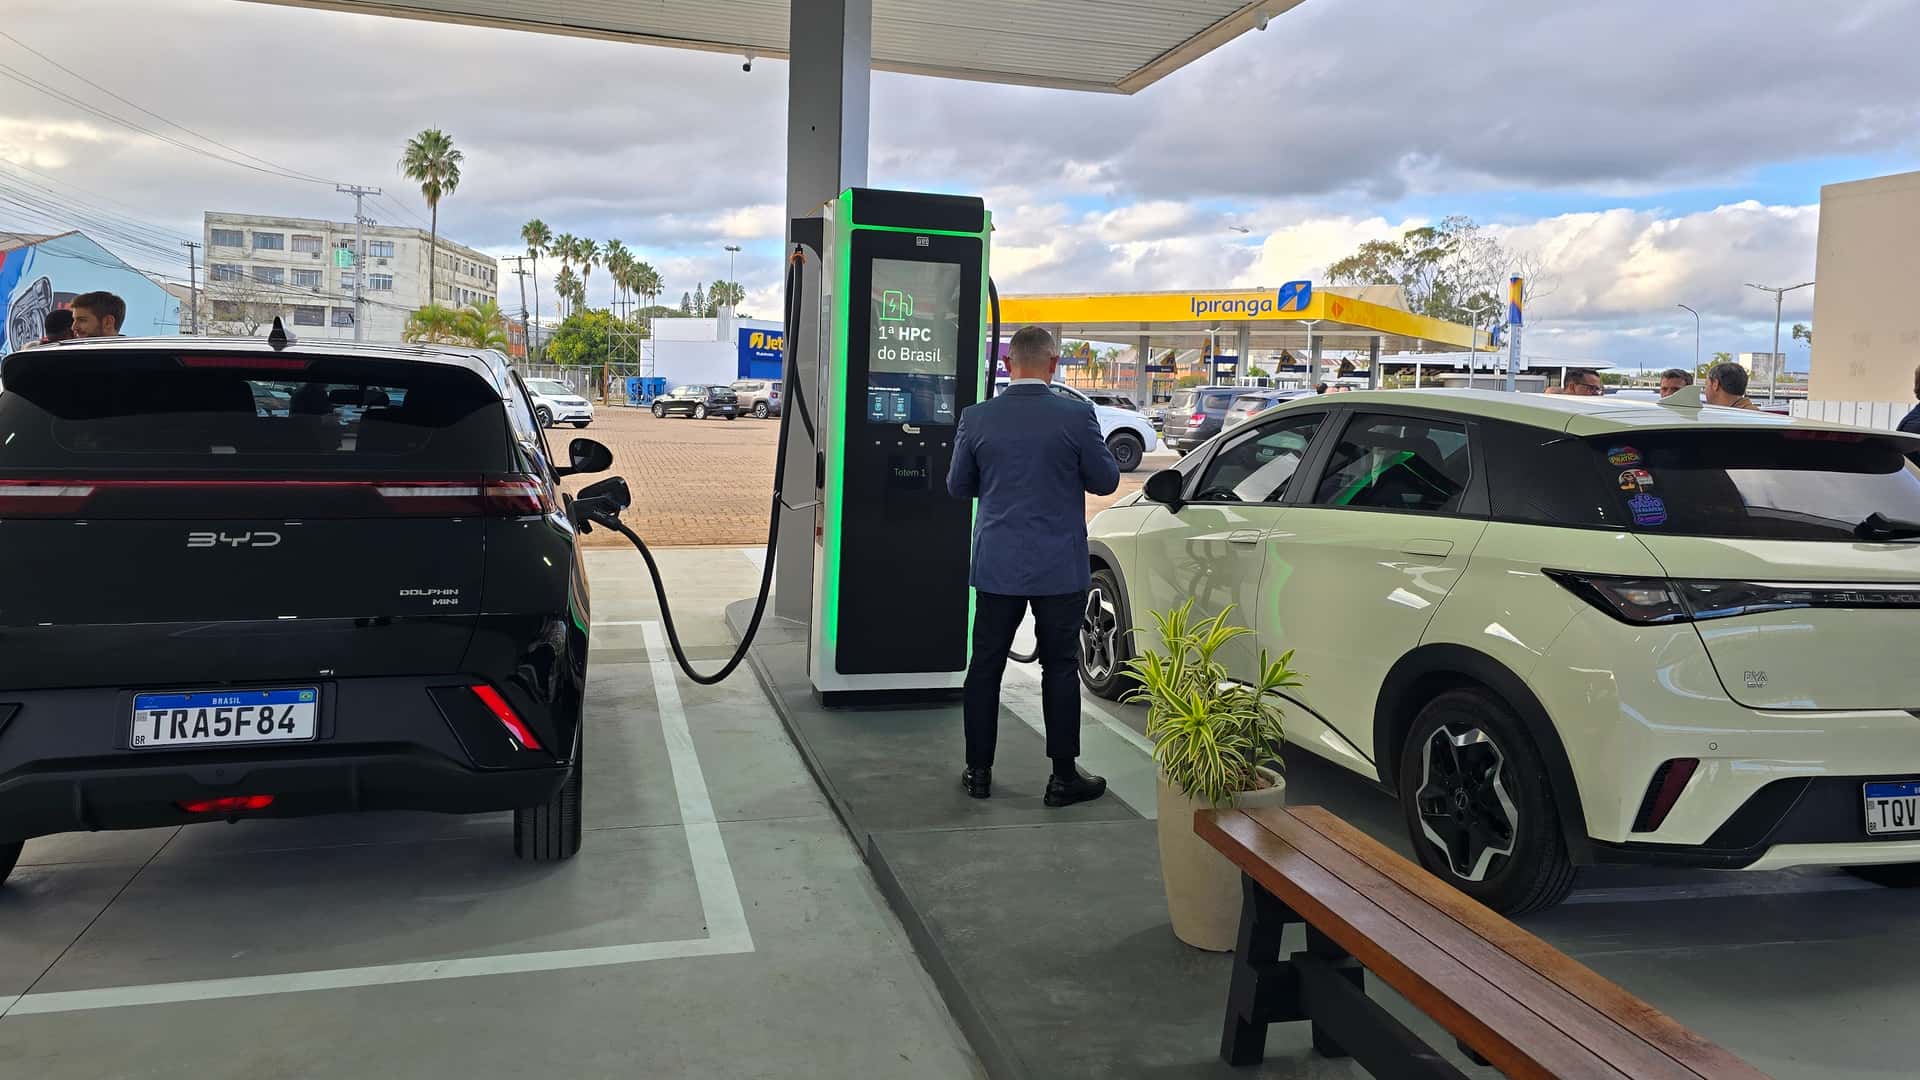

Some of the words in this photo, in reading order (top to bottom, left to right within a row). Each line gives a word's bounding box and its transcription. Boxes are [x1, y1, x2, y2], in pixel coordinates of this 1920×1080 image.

[1191, 296, 1273, 317] Ipiranga
[898, 327, 932, 342] HPC
[764, 336, 784, 351] Jet
[877, 346, 897, 360] do
[900, 347, 942, 362] Brasil
[893, 467, 919, 478] Totem
[187, 532, 281, 547] BYD
[212, 697, 241, 705] BRASIL
[150, 705, 296, 740] TRA5F84
[135, 735, 146, 745] BR
[1877, 798, 1916, 828] TQV
